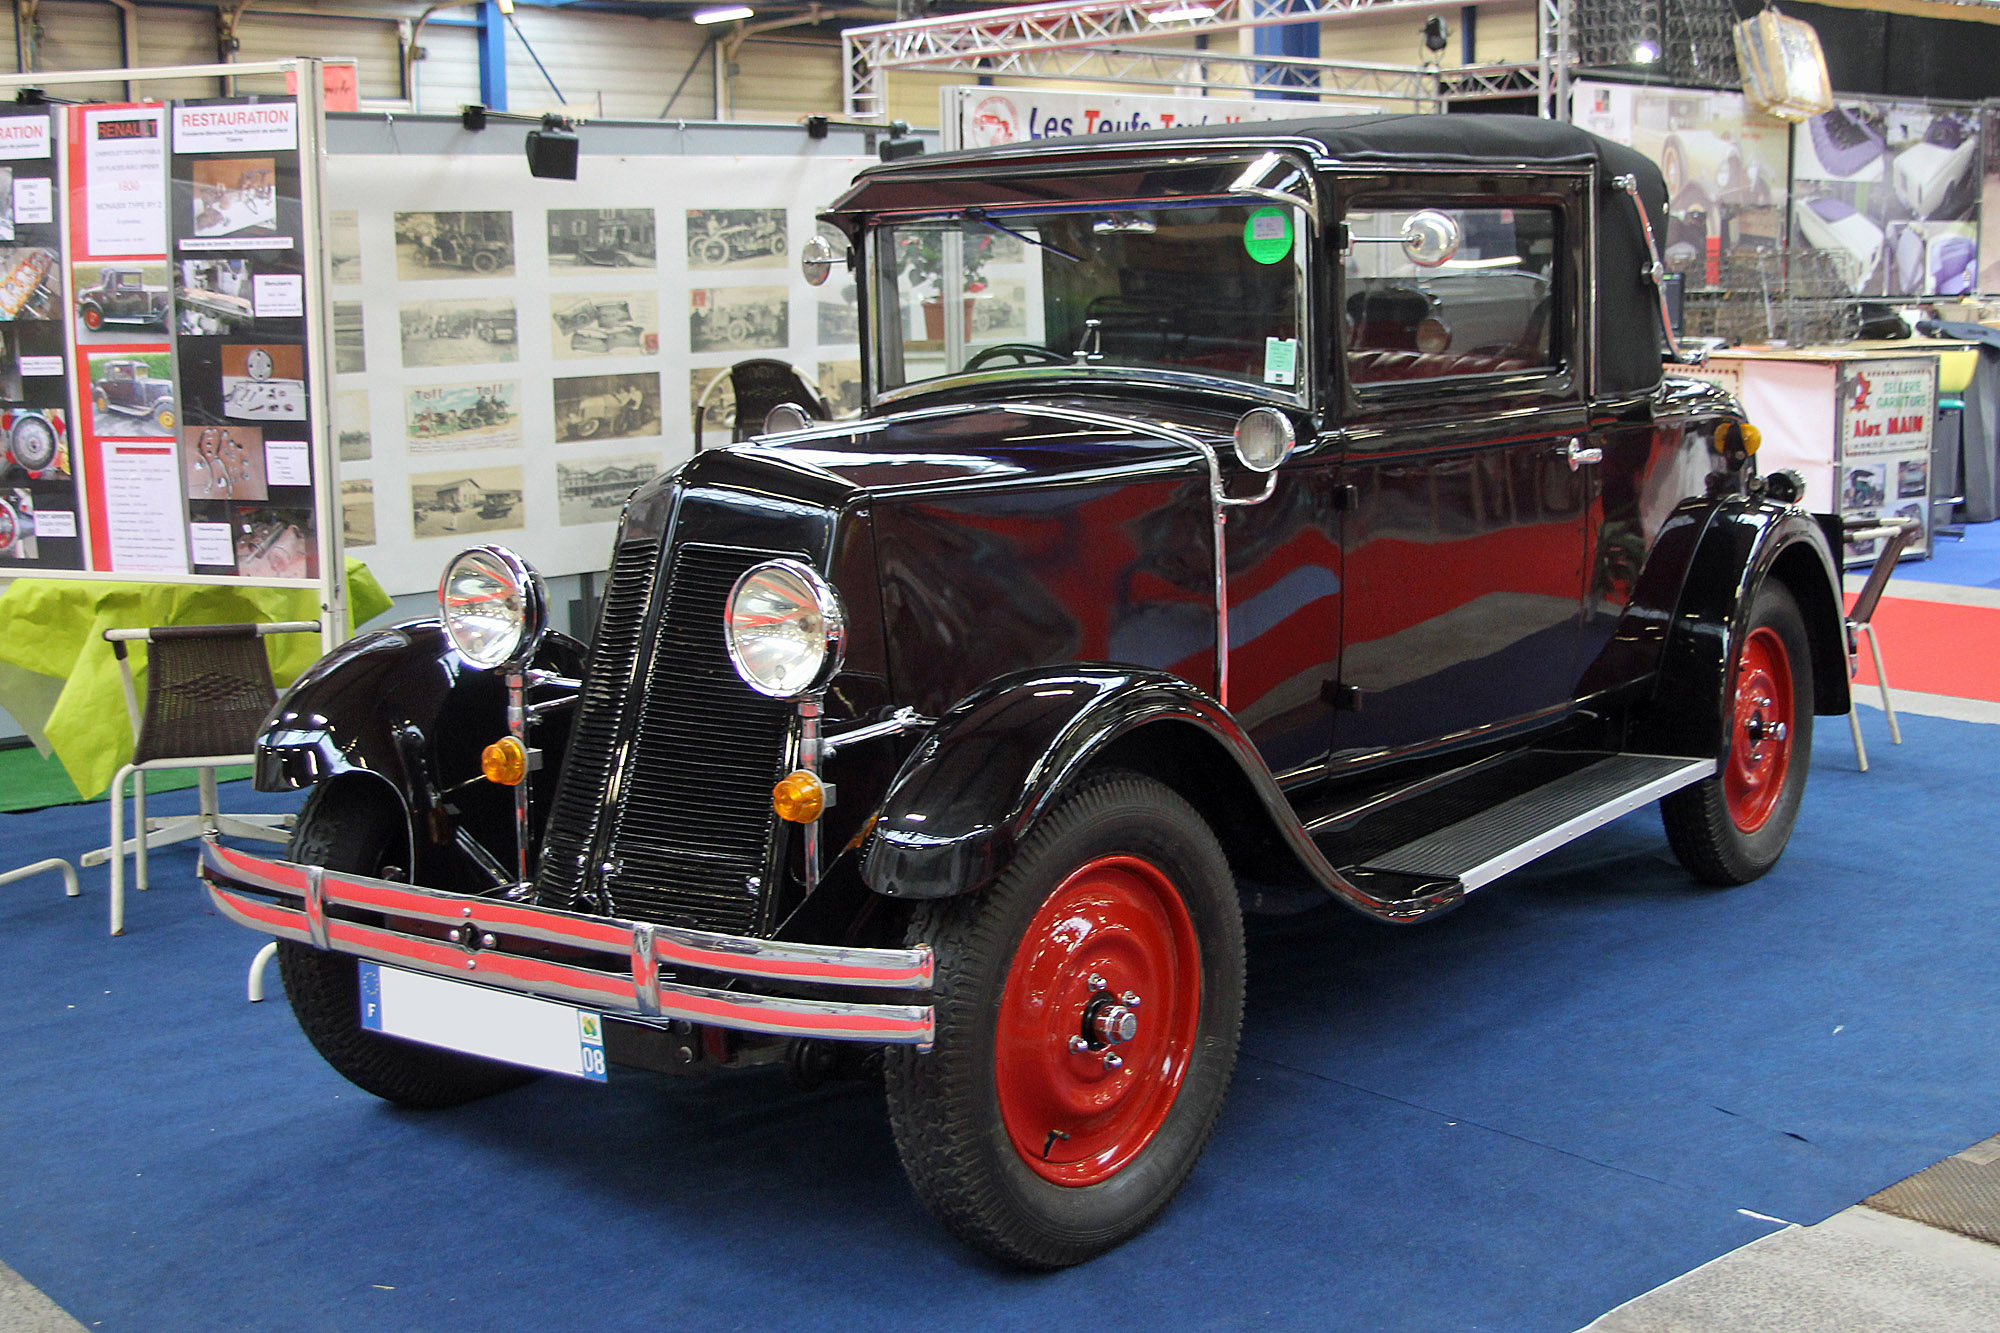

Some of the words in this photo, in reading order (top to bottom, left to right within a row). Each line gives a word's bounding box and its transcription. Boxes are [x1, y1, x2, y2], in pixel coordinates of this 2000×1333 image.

[181, 110, 289, 127] RESTAURATION
[1029, 107, 1073, 141] Les
[98, 121, 157, 137] RENAULT
[1853, 420, 1882, 438] Alex
[1887, 416, 1923, 435] MAIN
[368, 1003, 375, 1017] F
[582, 1046, 605, 1075] 08
